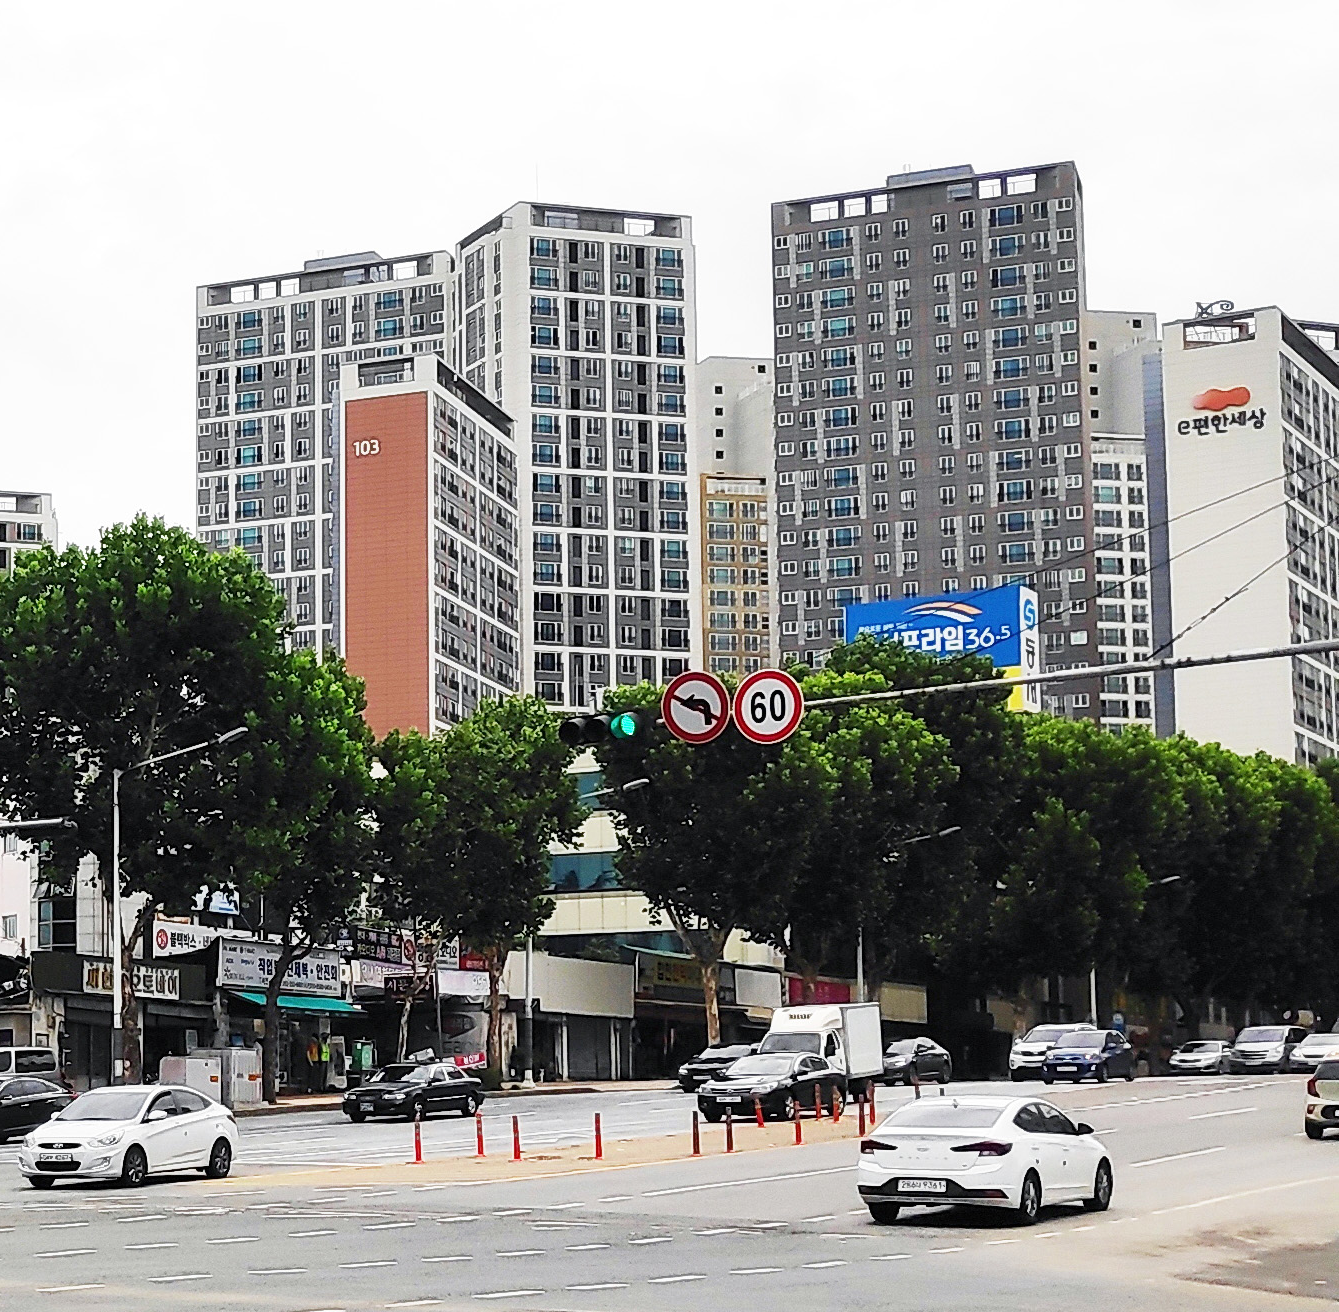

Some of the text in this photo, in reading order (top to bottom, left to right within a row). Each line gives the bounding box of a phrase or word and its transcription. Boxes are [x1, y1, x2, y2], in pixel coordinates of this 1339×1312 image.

[1177, 407, 1267, 436] e편한세상
[352, 439, 381, 457] 103
[750, 689, 786, 724] 60
[170, 931, 197, 950] 블랙박스
